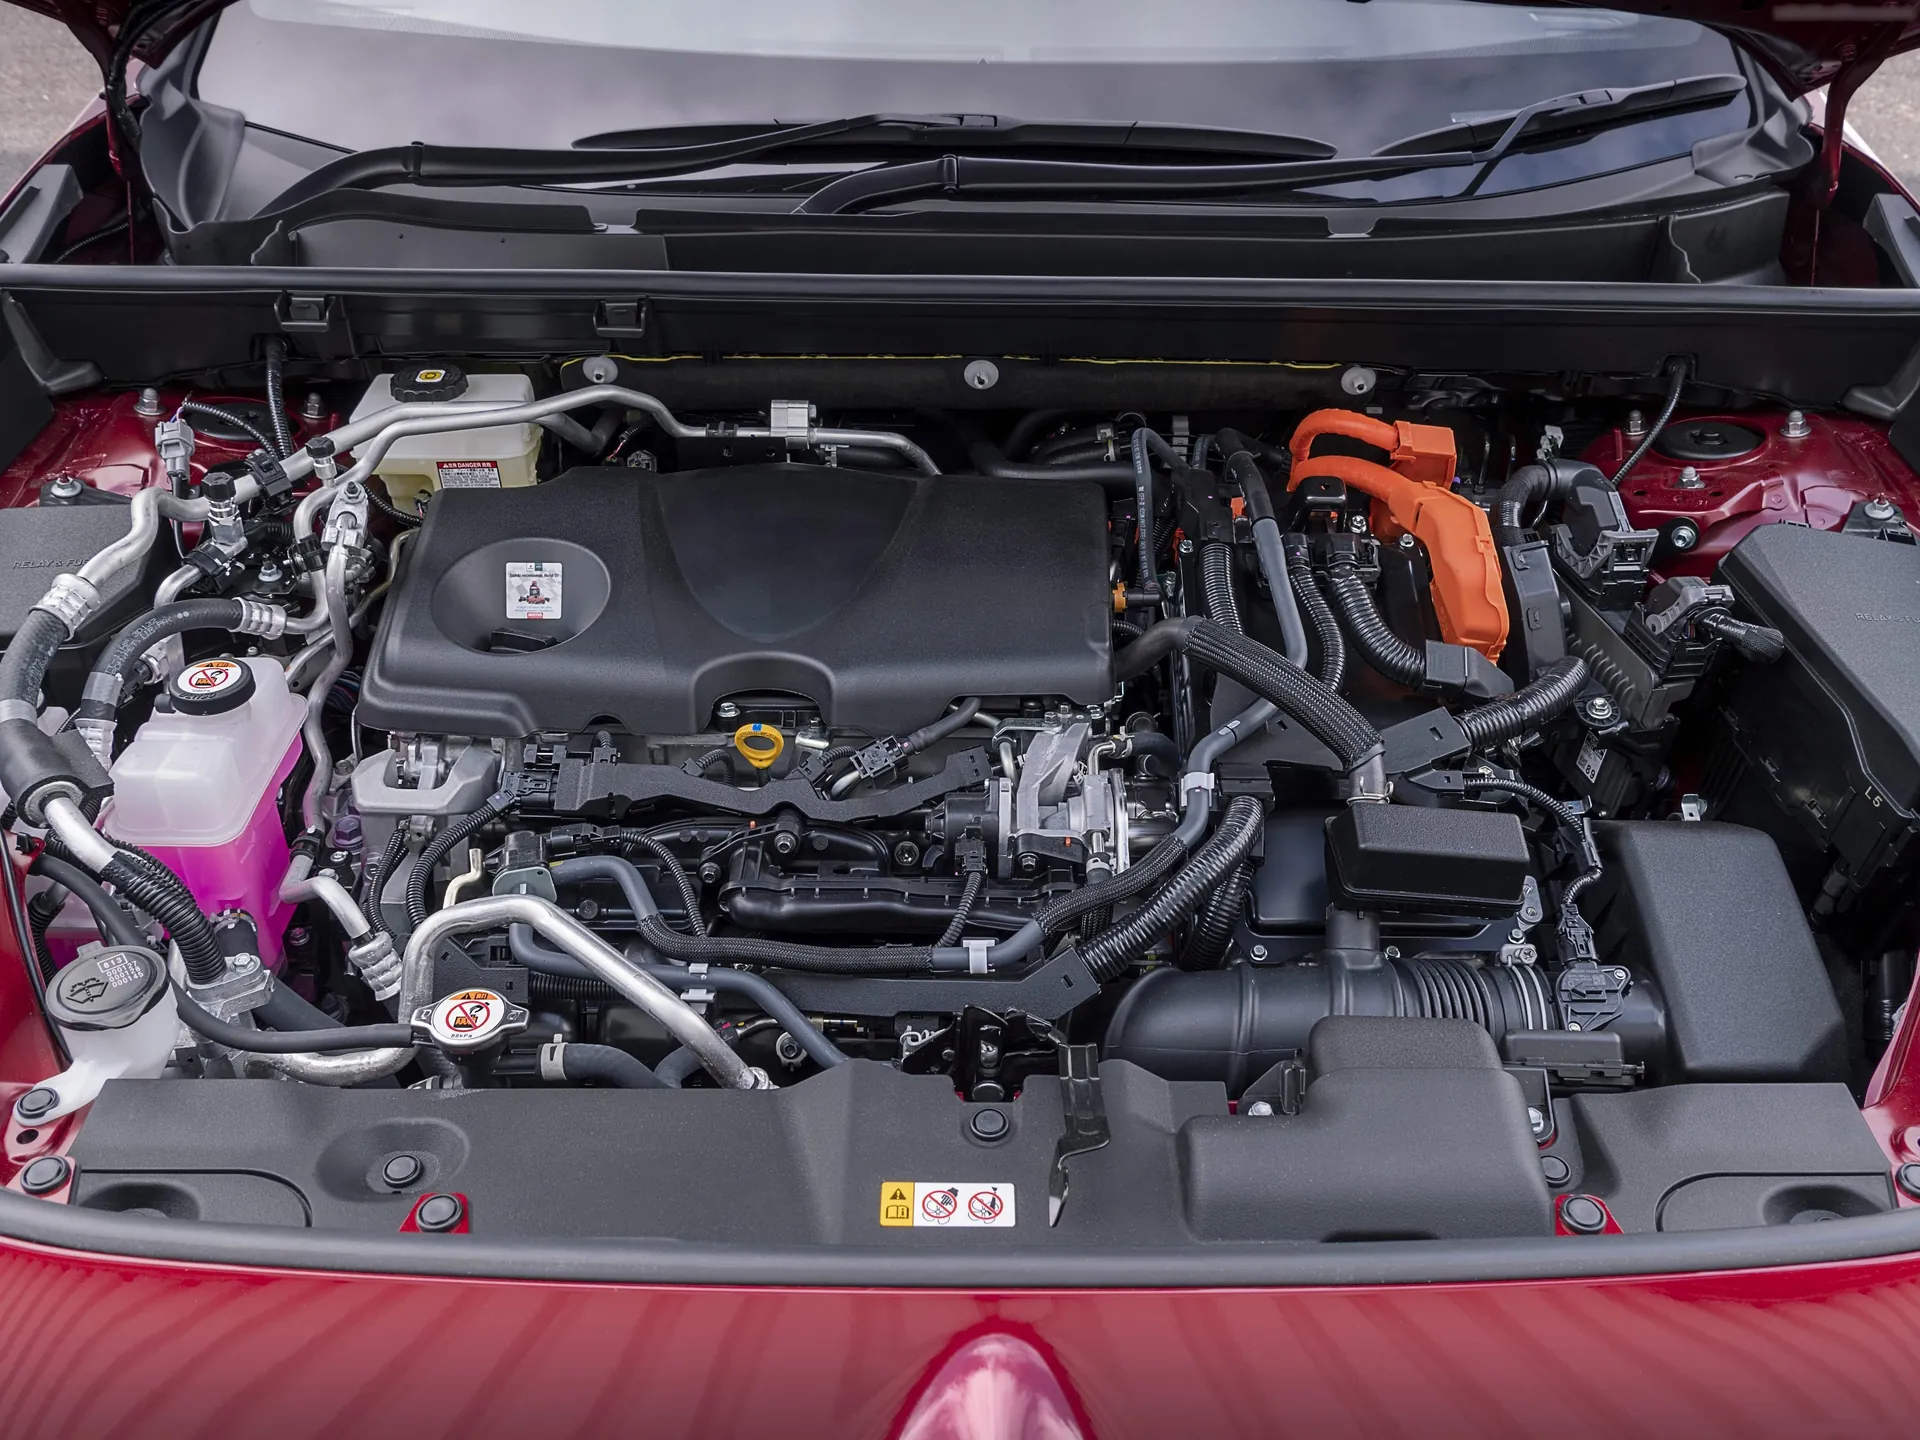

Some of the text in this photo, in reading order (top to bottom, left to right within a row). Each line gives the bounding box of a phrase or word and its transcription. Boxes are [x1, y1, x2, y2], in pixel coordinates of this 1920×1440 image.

[13, 560, 54, 569] RELAY
[55, 560, 63, 568] &
[1855, 612, 1892, 622] RELAY
[1864, 785, 1883, 807] L5
[106, 960, 137, 977] 000127
[112, 971, 144, 988] 000145
